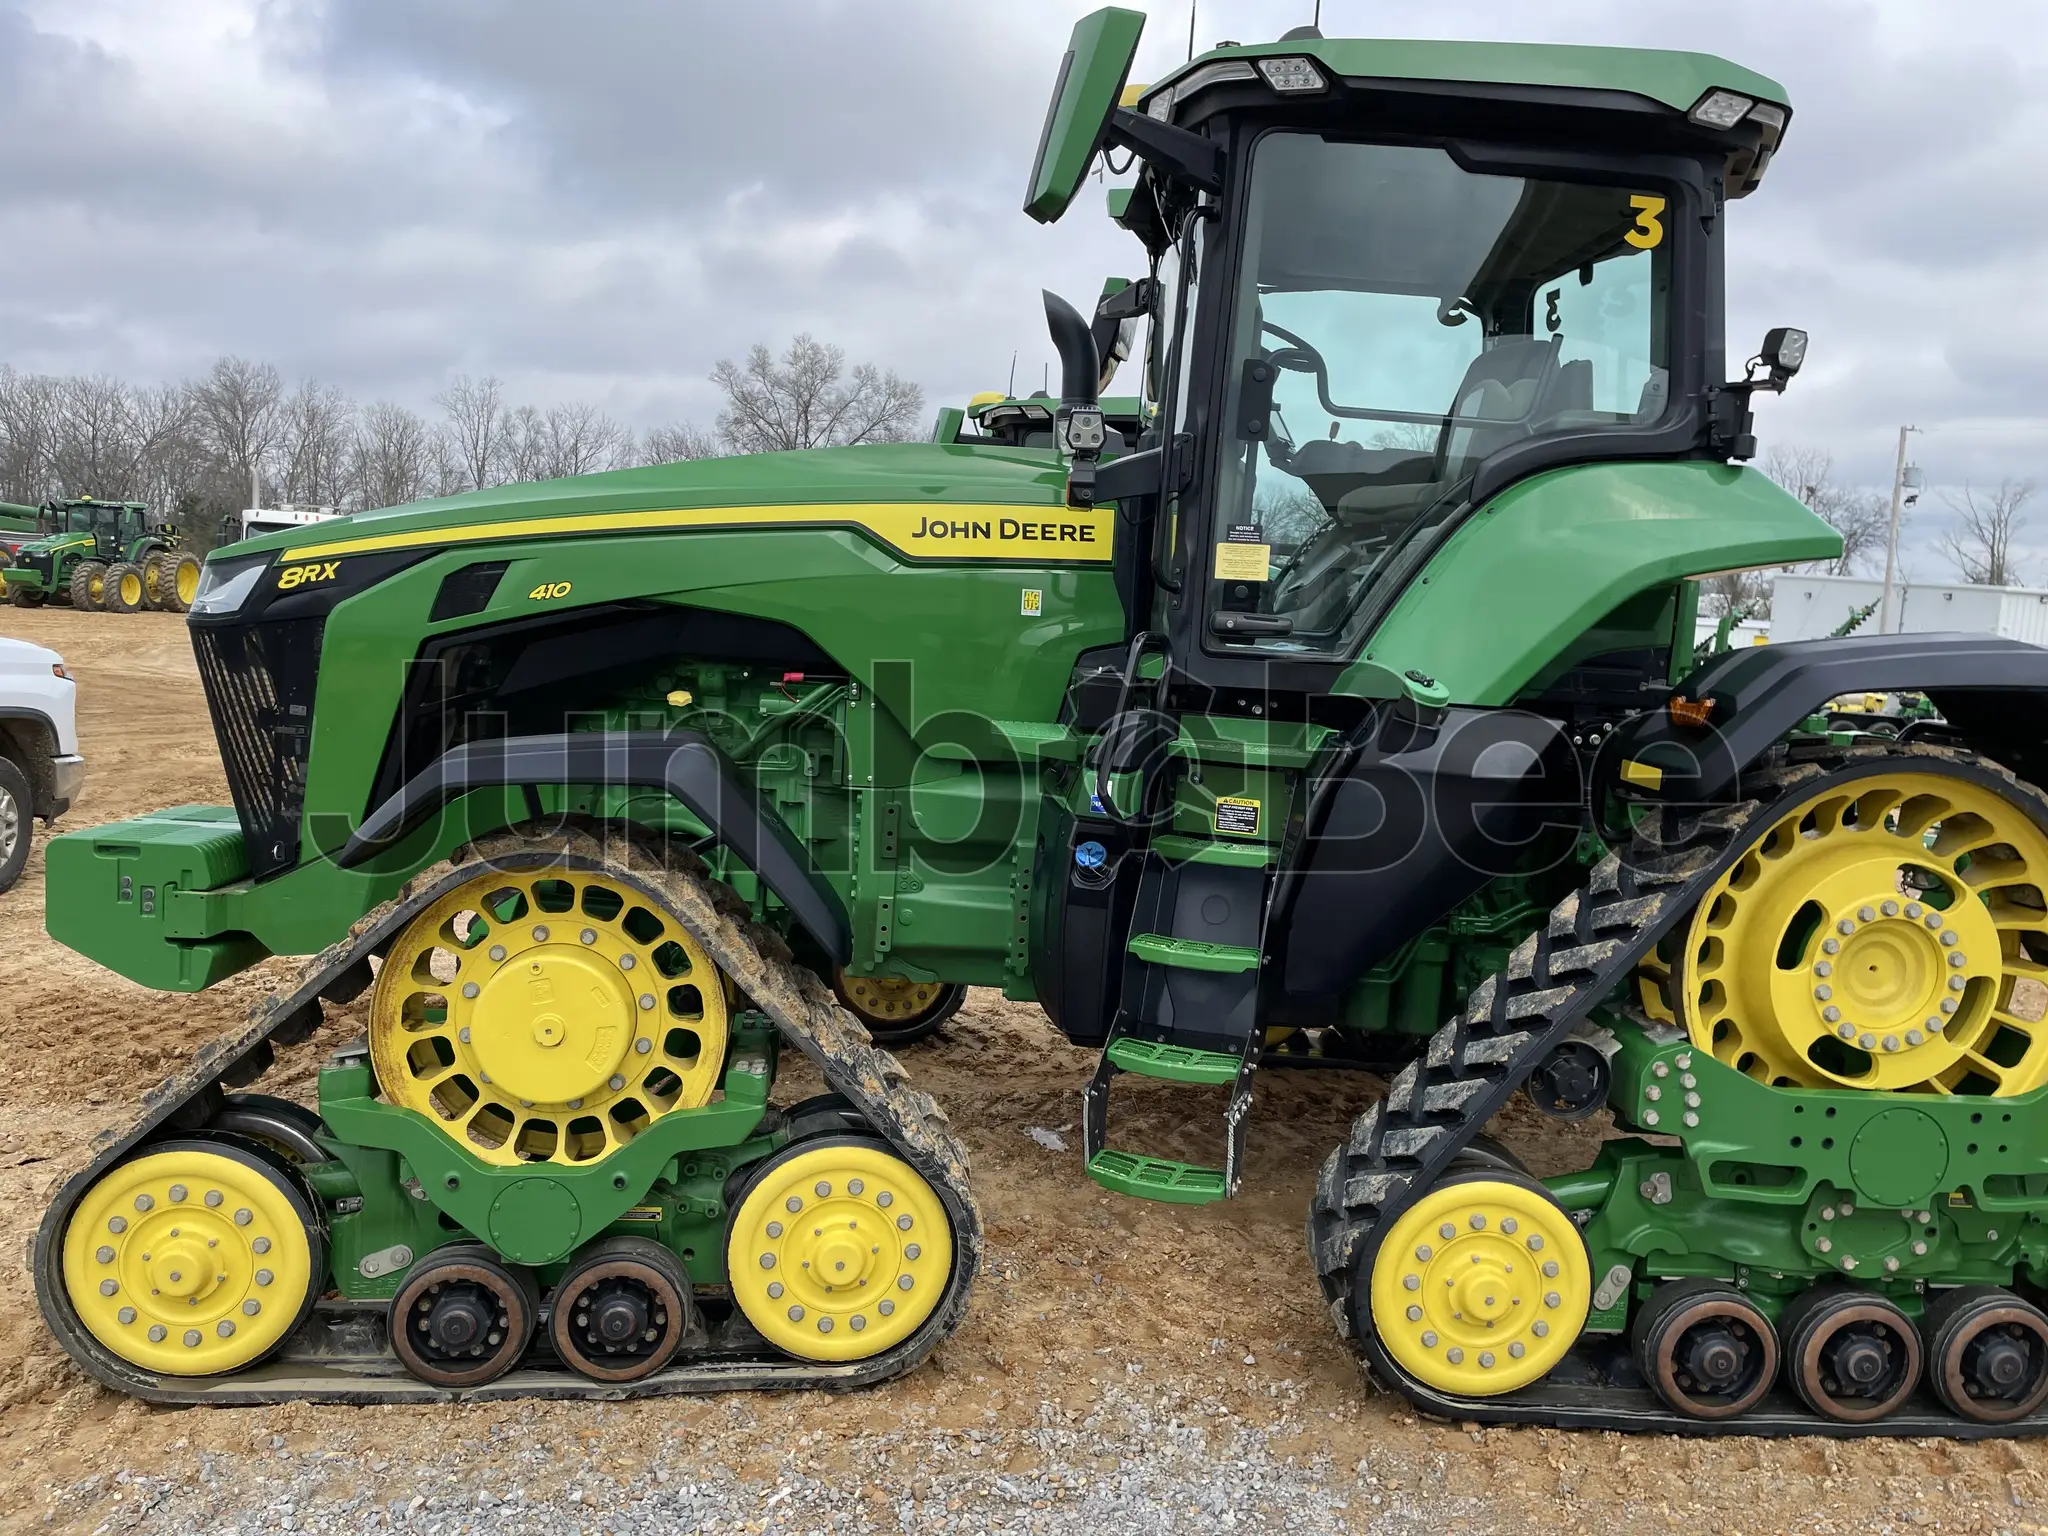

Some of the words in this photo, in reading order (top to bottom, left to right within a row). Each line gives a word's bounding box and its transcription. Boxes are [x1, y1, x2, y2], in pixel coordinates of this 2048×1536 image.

[1624, 195, 1666, 249] 3
[912, 517, 991, 539] JOHN
[999, 518, 1096, 542] DEERE
[278, 561, 342, 589] 8RX
[528, 581, 572, 601] 410
[1024, 591, 1040, 601] AG
[1024, 600, 1040, 610] UP
